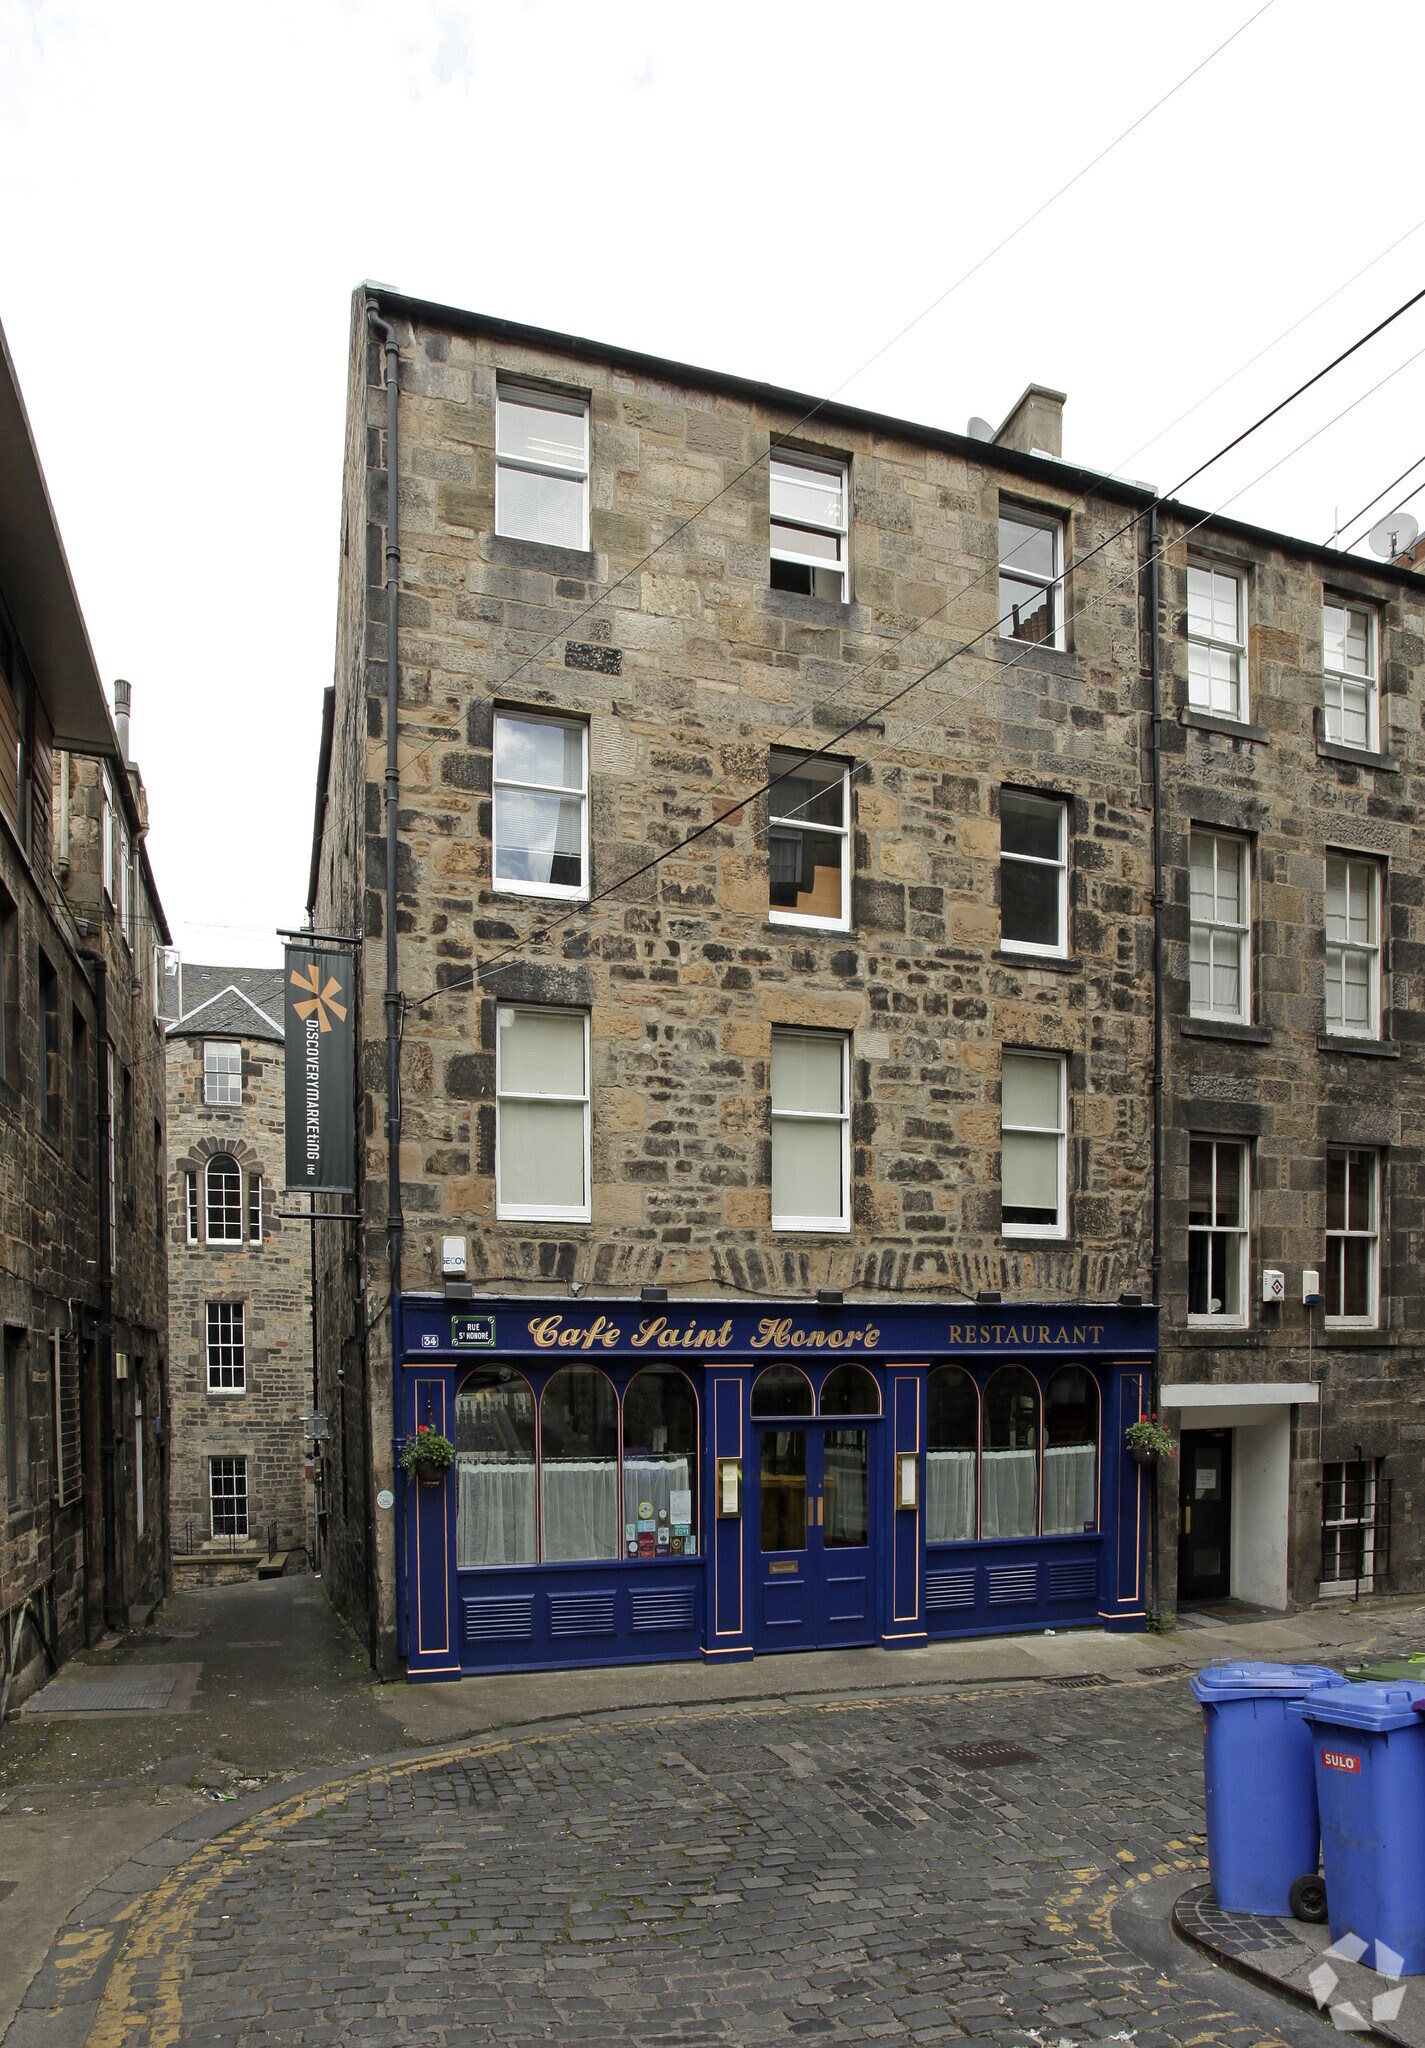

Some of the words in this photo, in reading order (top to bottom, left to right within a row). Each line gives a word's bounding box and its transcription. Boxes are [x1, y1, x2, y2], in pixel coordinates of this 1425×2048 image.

[467, 1323, 480, 1331] RUE
[527, 1314, 621, 1349] Café
[630, 1316, 734, 1348] Saint
[749, 1318, 880, 1348] Honoré
[948, 1325, 1104, 1344] RESTAURANT
[423, 1336, 437, 1346] 34
[1325, 1753, 1355, 1769] SULO
